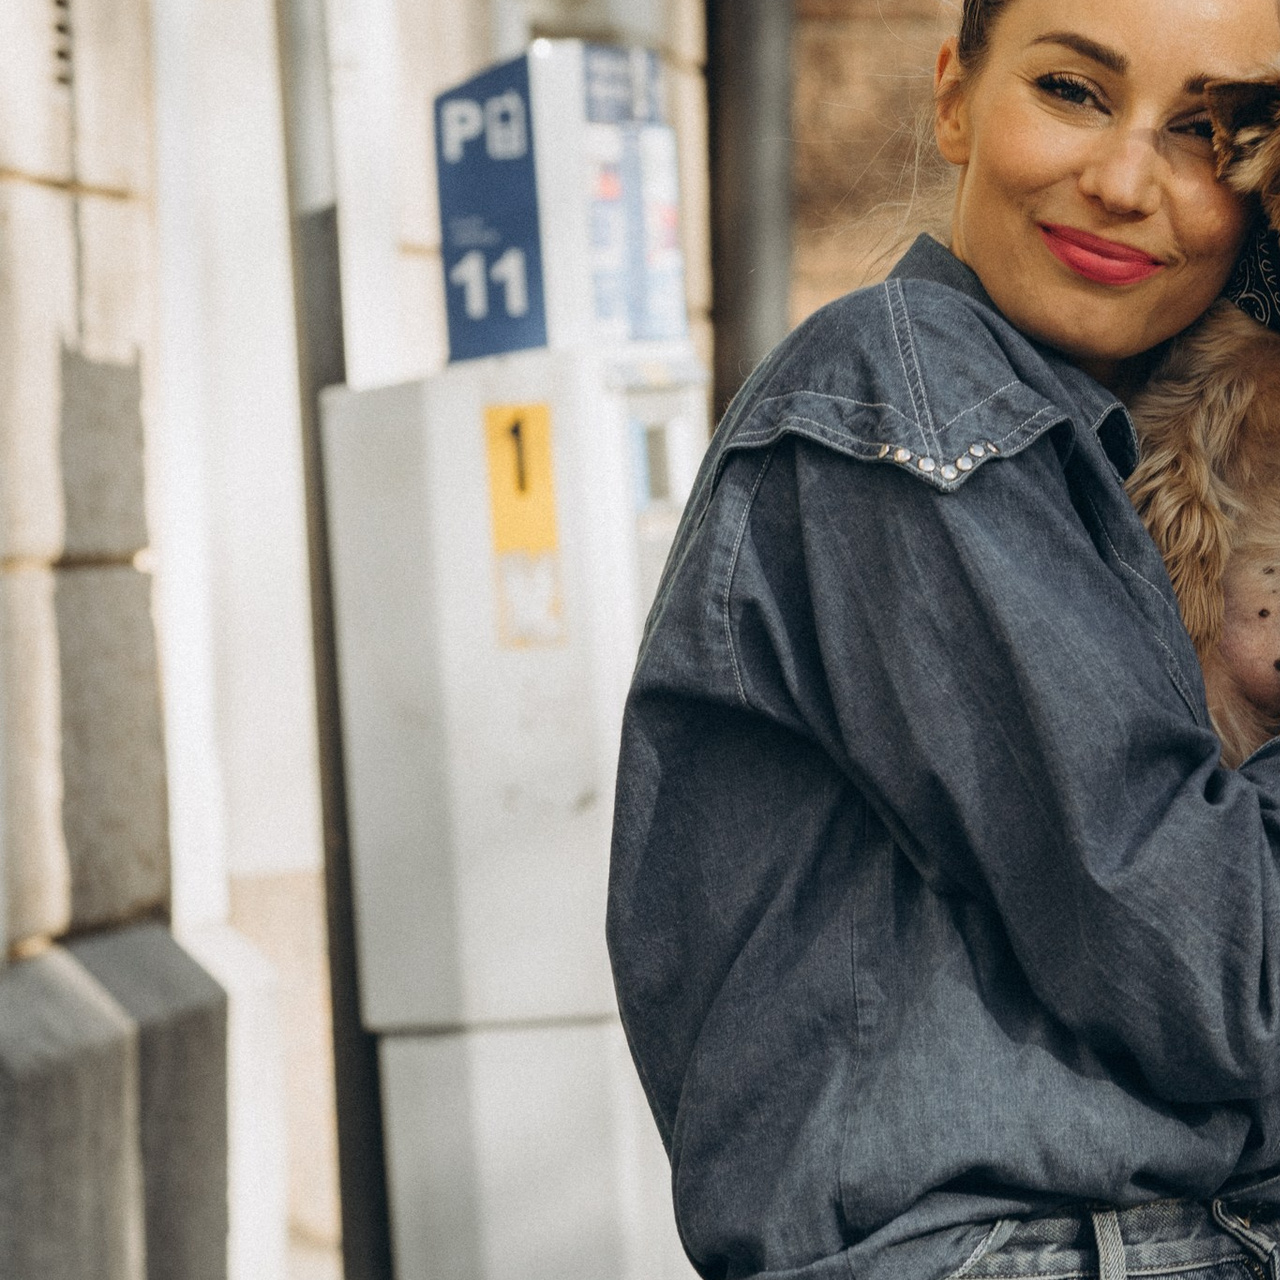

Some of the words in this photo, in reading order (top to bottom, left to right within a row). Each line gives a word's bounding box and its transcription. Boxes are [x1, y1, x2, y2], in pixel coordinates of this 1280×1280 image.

[442, 100, 482, 163] P
[449, 247, 528, 320] 11
[508, 417, 527, 494] 1
